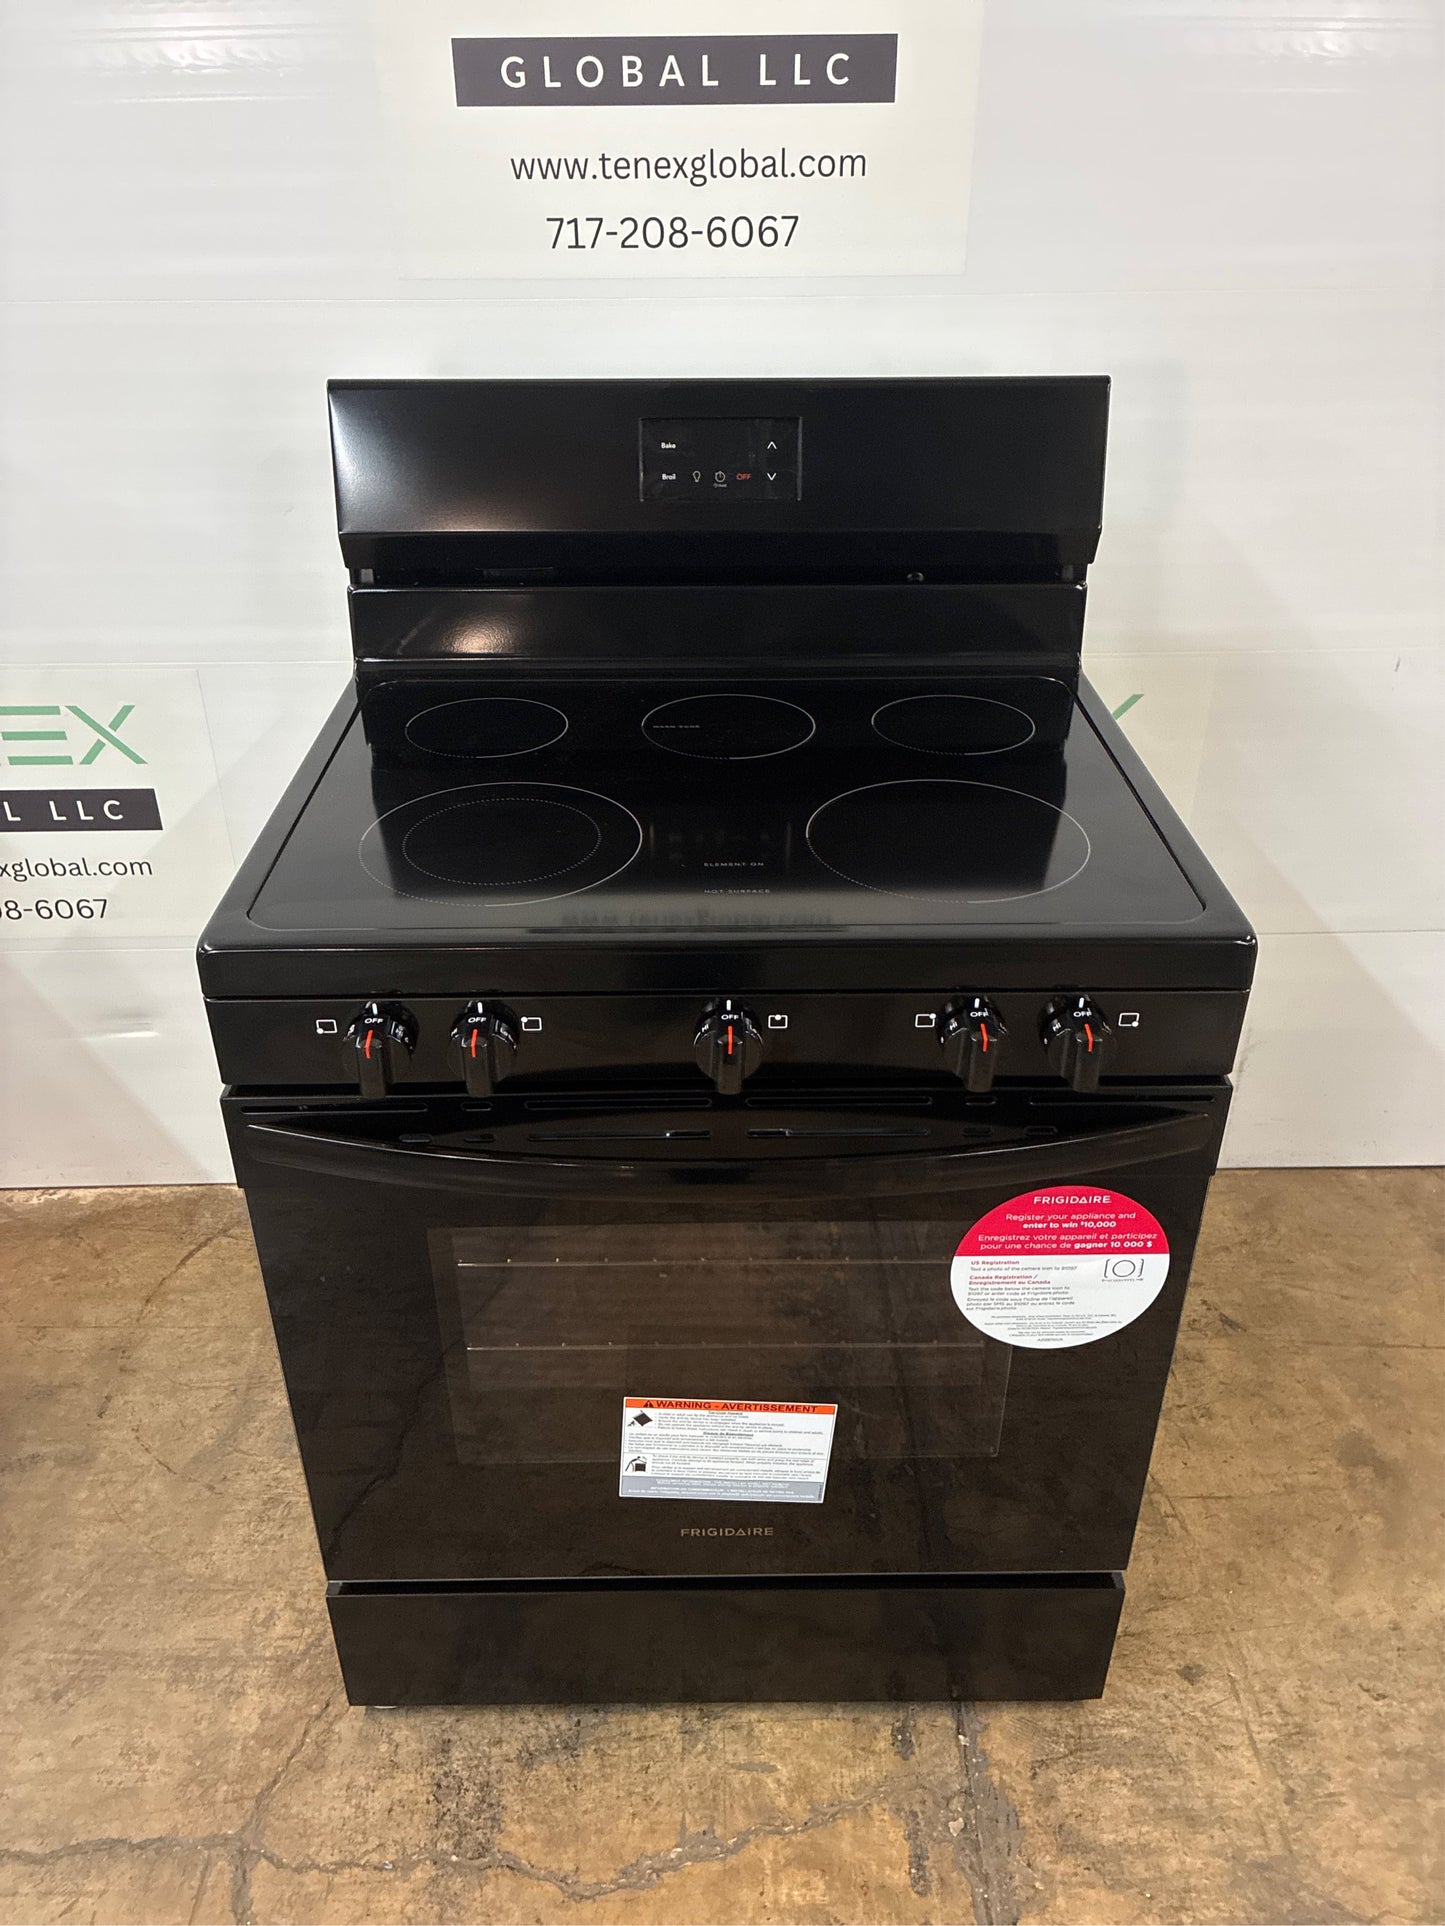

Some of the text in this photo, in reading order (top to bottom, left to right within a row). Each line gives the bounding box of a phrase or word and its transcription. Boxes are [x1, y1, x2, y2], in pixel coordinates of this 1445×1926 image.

[500, 53, 851, 88] GLOBAL LLC
[510, 148, 867, 187] www.tenexglobal.com
[546, 215, 799, 249] 717-208-6067
[49, 800, 124, 821] LLC
[0, 899, 107, 921] 8-6067
[1033, 1196, 1112, 1204] FRIGIDAIRE
[1006, 1214, 1044, 1222] Register
[1070, 1212, 1116, 1220] appliance
[1080, 1221, 1116, 1229] $10,000
[978, 1234, 1030, 1242] Enregistrez
[1060, 1233, 1097, 1241] appareil
[1111, 1232, 1157, 1240] participez
[656, 1400, 712, 1409] WARNING
[722, 1403, 818, 1413] AVERTISSEMENT
[680, 1527, 774, 1537] FRIGIDAIRE
